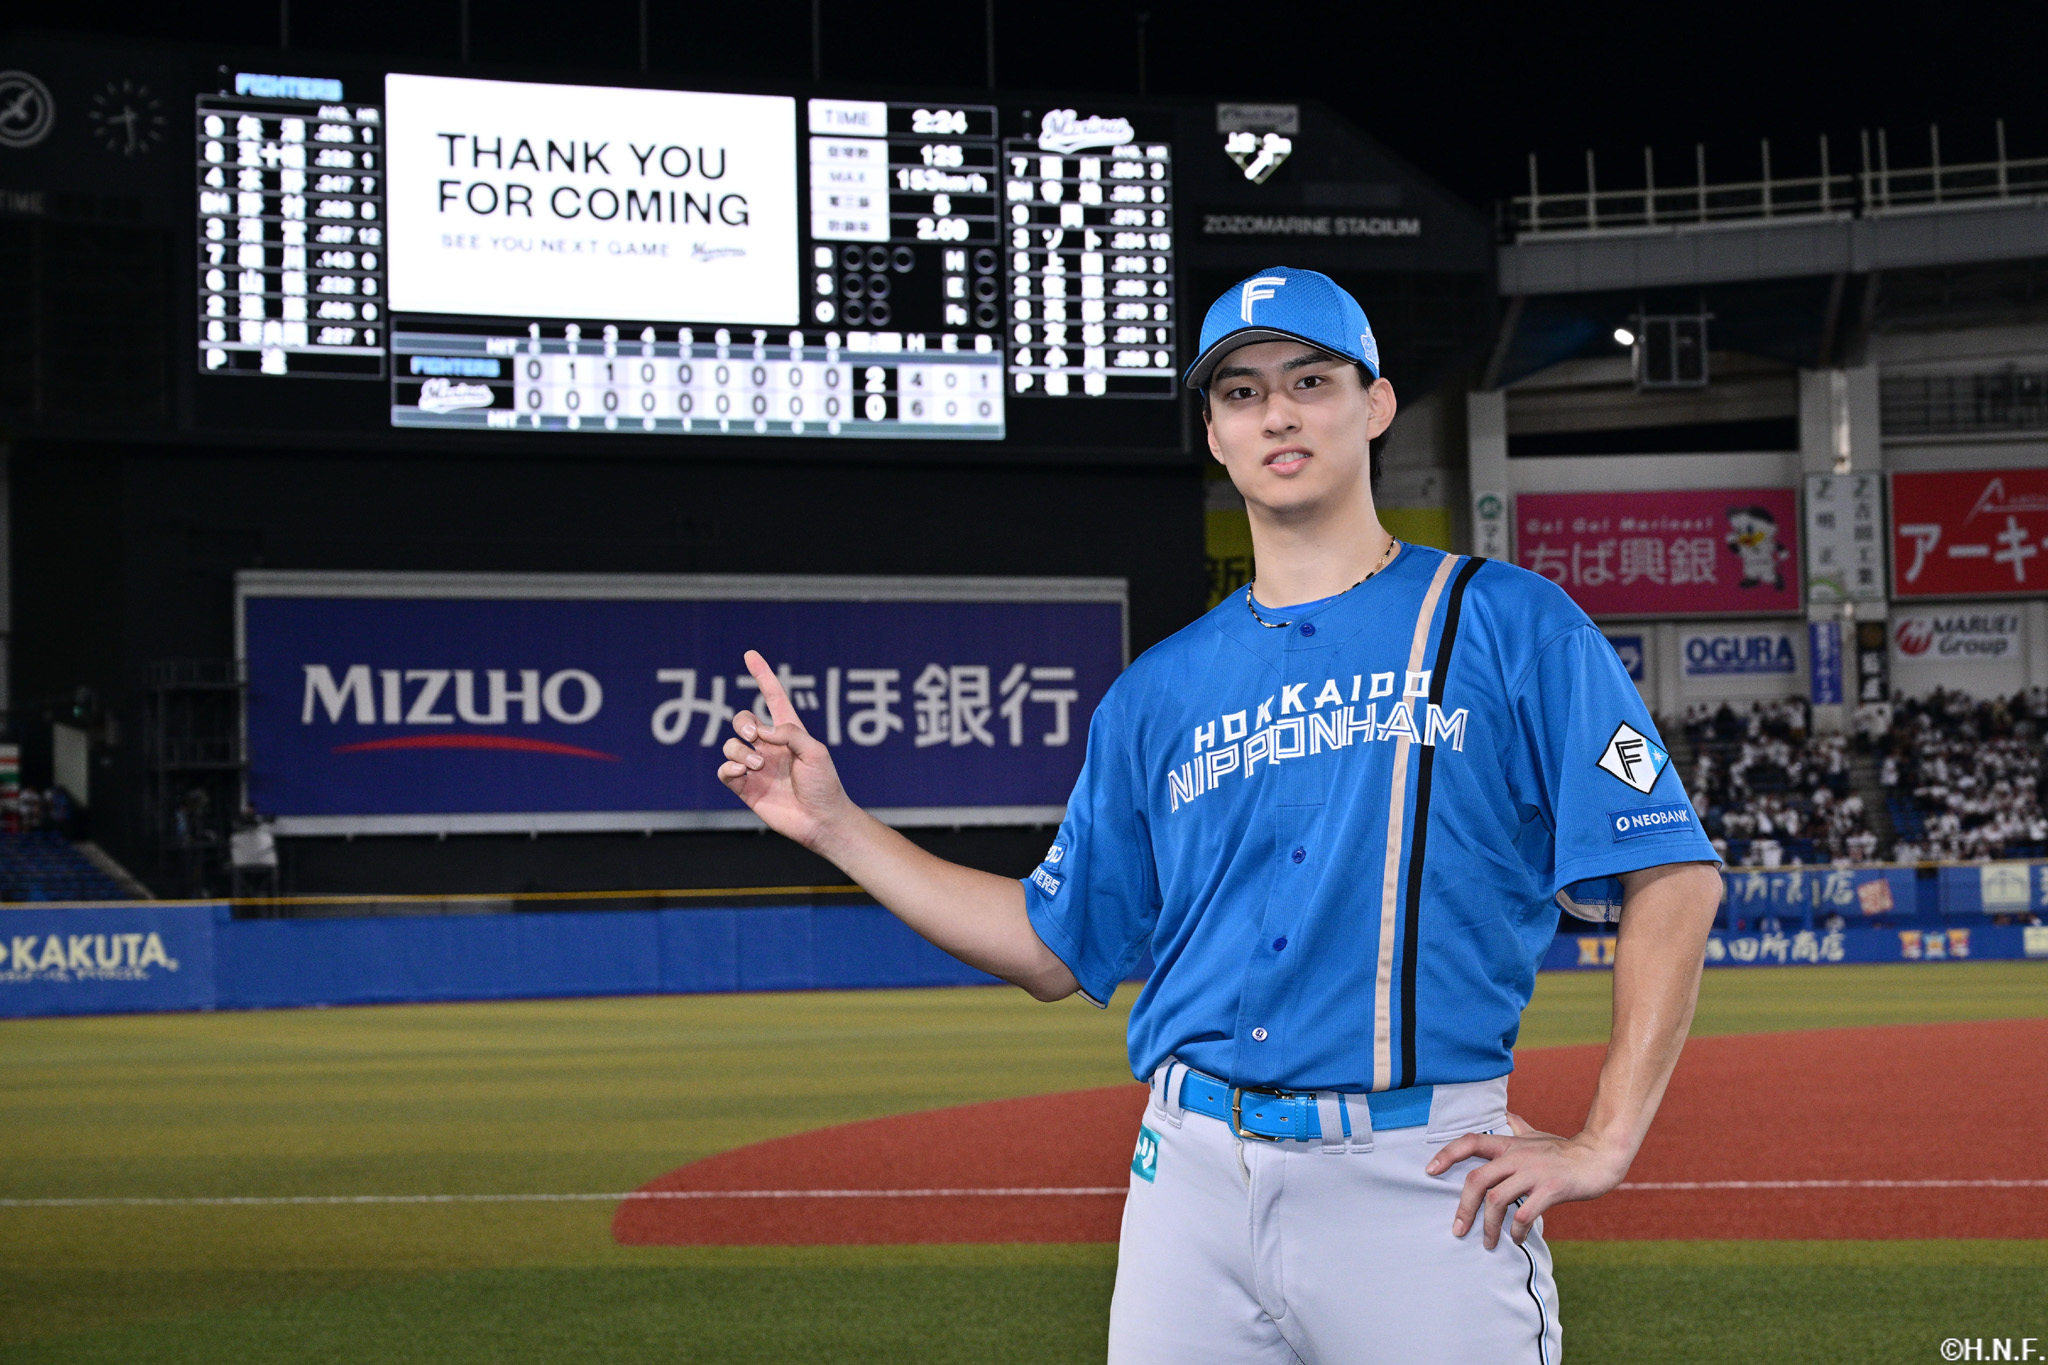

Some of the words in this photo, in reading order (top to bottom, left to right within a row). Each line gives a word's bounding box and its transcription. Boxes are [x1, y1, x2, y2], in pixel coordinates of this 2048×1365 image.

[912, 109, 967, 133] 2:24
[437, 132, 611, 175] THANK
[628, 142, 725, 179] YOU
[1011, 156, 1028, 178] 7
[437, 180, 533, 217] FOR
[550, 186, 749, 226] COMING
[1203, 214, 1330, 235] ZOZOMARINE
[1333, 216, 1420, 236] STADIUM
[206, 242, 225, 265] 7
[441, 233, 480, 249] SEE
[490, 236, 532, 252] YOU
[540, 239, 599, 254] NEXT
[607, 242, 669, 257] GAME
[1241, 277, 1287, 325] F
[206, 347, 227, 370] P
[527, 359, 542, 380] 0
[568, 361, 577, 380] 1
[606, 363, 615, 381] 1
[641, 363, 655, 383] 0
[678, 364, 693, 384] 0
[716, 365, 730, 386] 0
[752, 366, 768, 387] 0
[789, 367, 804, 388] 0
[825, 368, 841, 389] 0
[865, 366, 886, 393] 2
[911, 373, 923, 387] 4
[945, 373, 957, 389] 0
[981, 373, 988, 388] 1
[1015, 372, 1033, 394] P
[527, 389, 542, 410] 0
[565, 390, 580, 411] 0
[603, 391, 618, 411] 0
[641, 392, 655, 412] 0
[678, 393, 693, 414] 0
[716, 394, 730, 414] 0
[752, 395, 768, 416] 0
[789, 396, 804, 417] 0
[825, 397, 841, 418] 0
[865, 394, 886, 421] 0
[945, 401, 958, 417] 0
[979, 401, 991, 417] 0
[1573, 517, 1610, 533] Go!
[1620, 515, 1713, 532] Marines!
[1524, 538, 1717, 585] ちば興銀
[1899, 514, 2048, 584] アーキ
[1686, 636, 1797, 665] OGURA
[1938, 634, 2008, 657] Group
[302, 665, 603, 725] MIZUHO
[651, 663, 1078, 747] みずほ銀行
[1194, 670, 1432, 754] HOKKAIDO
[1167, 702, 1469, 813] NIPPONHAM
[1614, 738, 1645, 784] F
[1631, 809, 1690, 829] NEOBANK
[12, 932, 170, 971] KAKUTA
